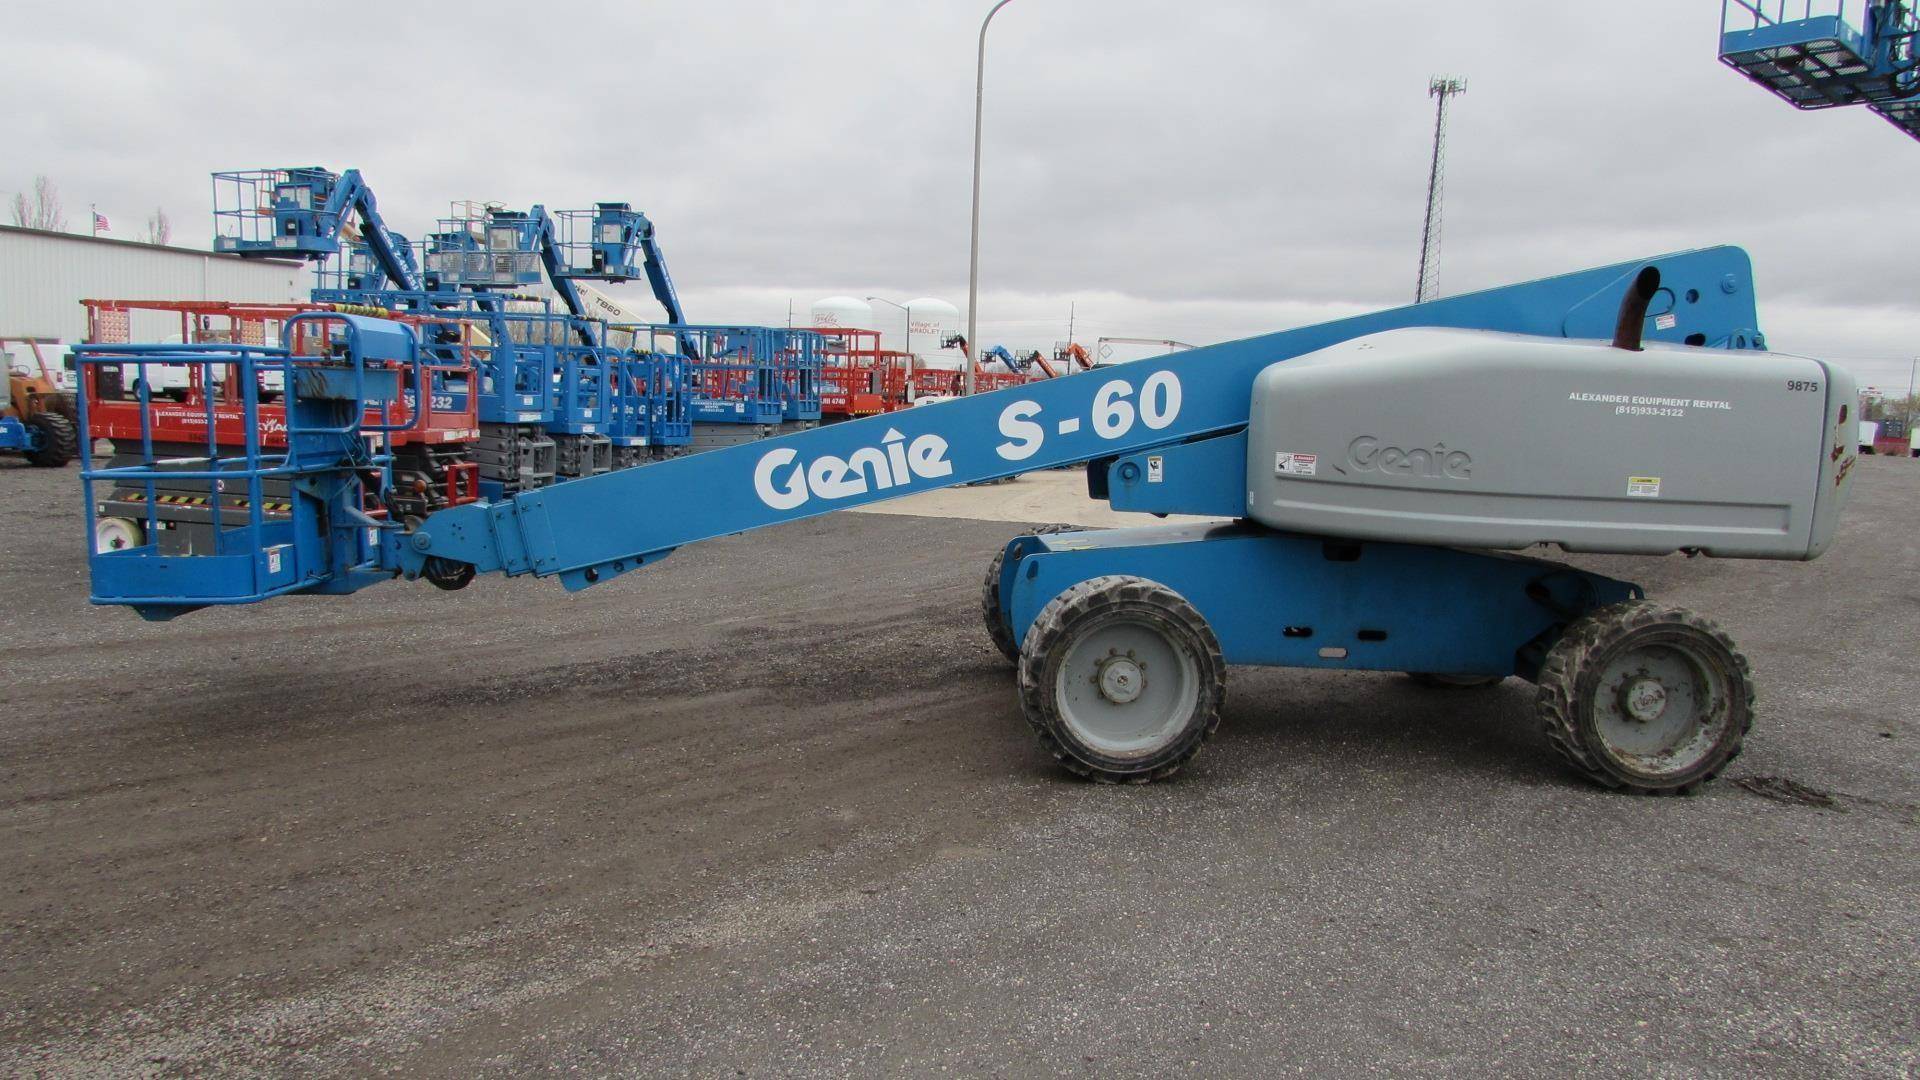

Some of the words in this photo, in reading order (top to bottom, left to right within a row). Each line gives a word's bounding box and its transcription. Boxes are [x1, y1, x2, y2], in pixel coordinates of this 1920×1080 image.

[595, 296, 622, 316] TB60
[1787, 380, 1818, 392] 9875
[1569, 392, 1629, 404] ALEXANDER
[1632, 395, 1690, 407] EQUIPMENT
[1692, 399, 1732, 410] RENTAL
[1615, 405, 1684, 417] (815)933-2122
[1347, 435, 1471, 480] Genie
[754, 427, 953, 510] Genie
